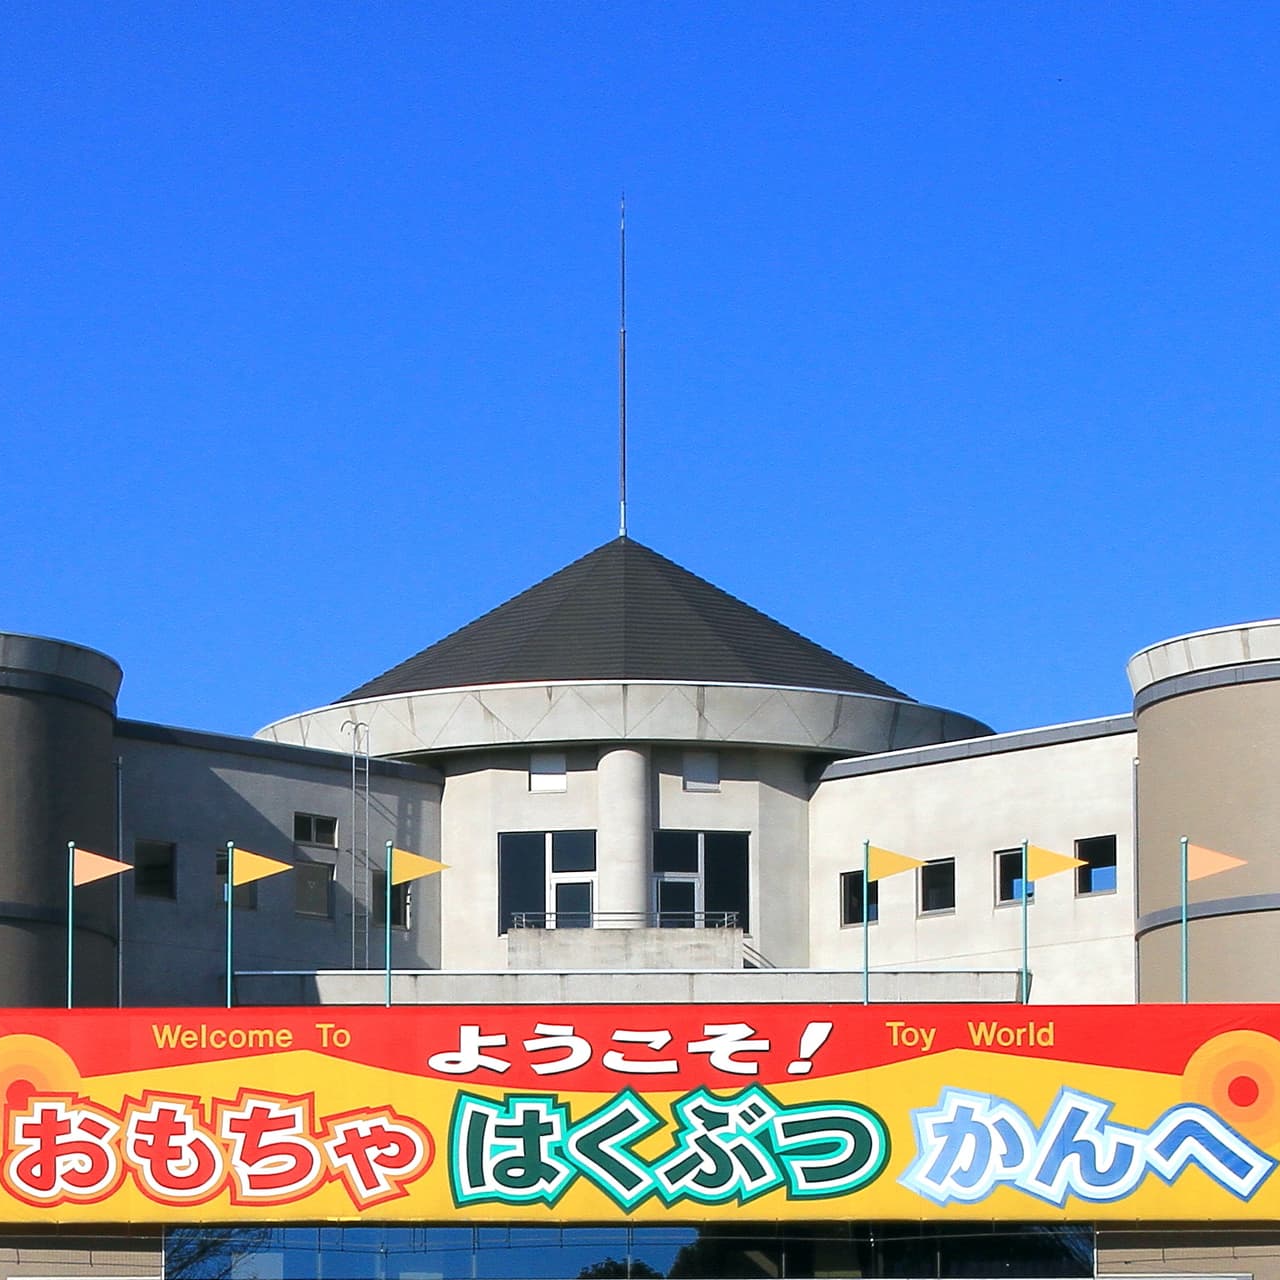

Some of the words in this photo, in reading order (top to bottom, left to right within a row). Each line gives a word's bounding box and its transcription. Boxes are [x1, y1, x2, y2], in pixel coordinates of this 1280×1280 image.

[152, 1023, 293, 1049] Welcome
[315, 1023, 351, 1048] To
[885, 1021, 937, 1052] Toy
[967, 1021, 1055, 1048] World
